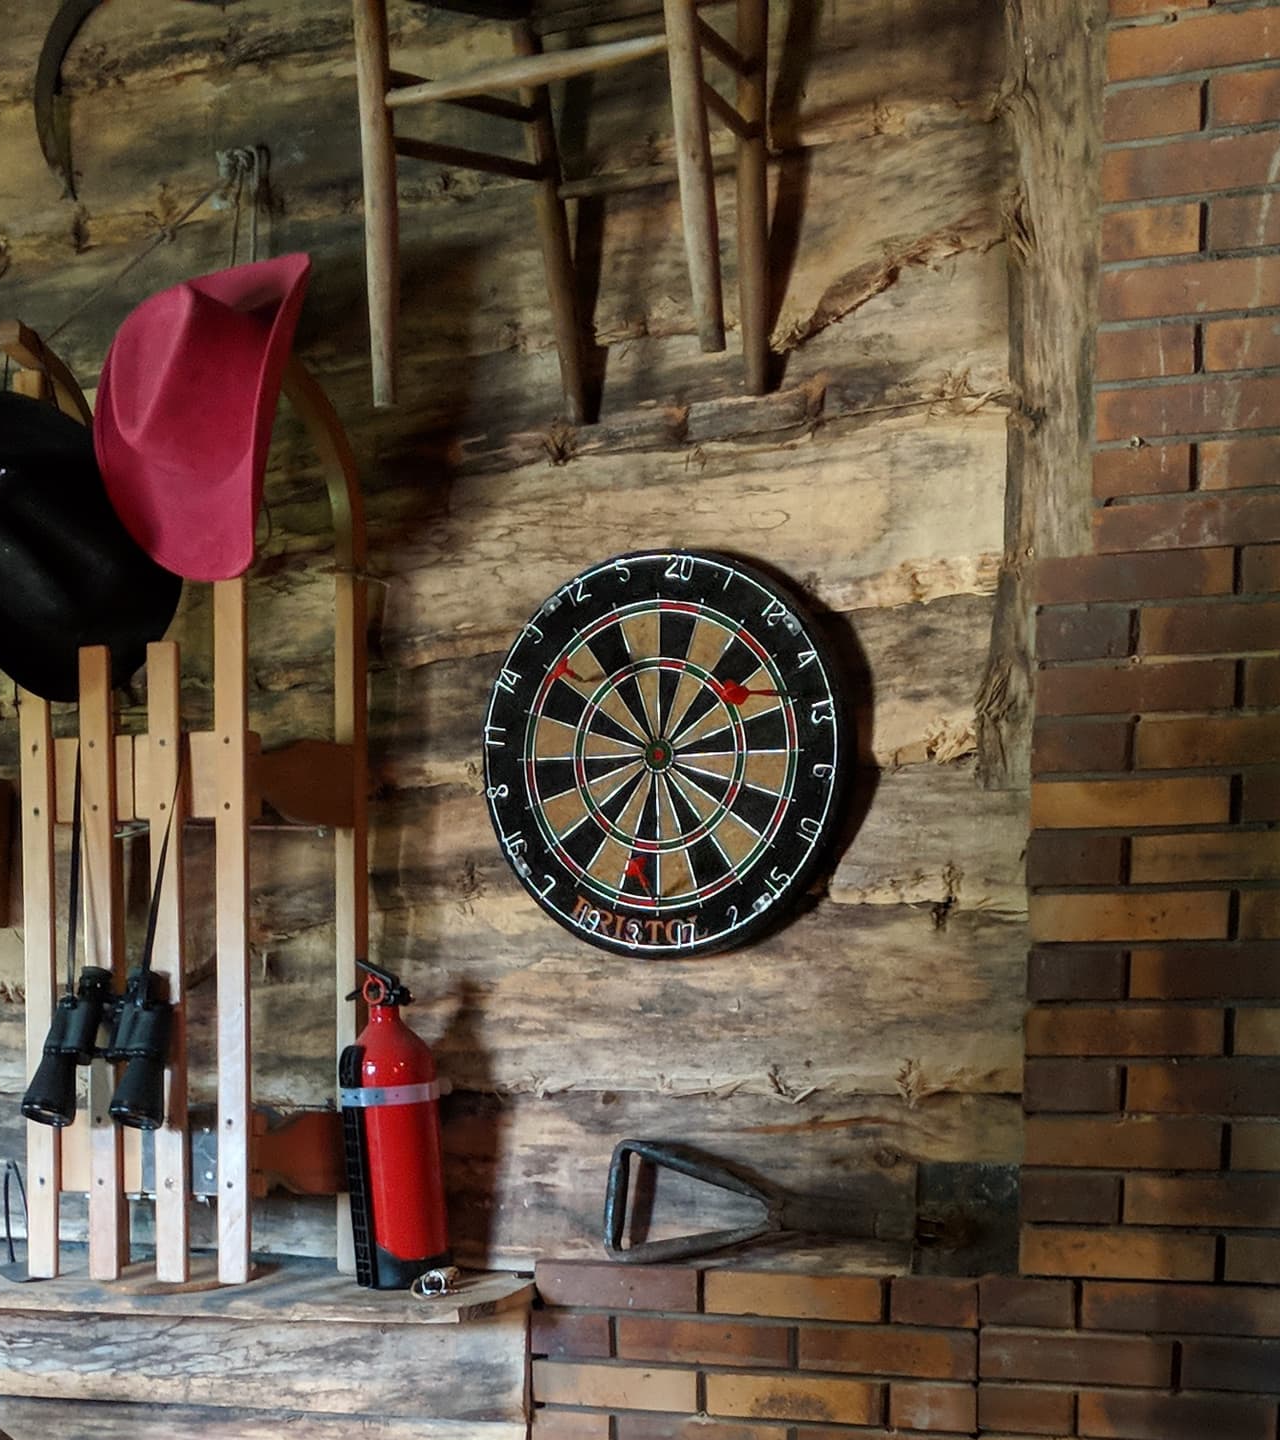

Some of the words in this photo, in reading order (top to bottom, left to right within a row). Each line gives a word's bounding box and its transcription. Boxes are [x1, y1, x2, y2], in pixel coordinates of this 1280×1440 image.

[616, 561, 631, 583] 5
[665, 555, 694, 580] 20
[723, 568, 735, 591] 1
[565, 579, 592, 607] 12
[762, 597, 787, 627] 18
[525, 622, 543, 644] 9
[797, 650, 817, 669] 4
[496, 668, 522, 695] 14
[812, 699, 834, 724] 13
[813, 764, 836, 780] 6
[487, 785, 509, 800] 8
[797, 818, 822, 843] 10
[502, 831, 528, 863] 16
[540, 874, 555, 898] 7
[765, 867, 792, 899] 15
[576, 904, 601, 934] 19
[726, 905, 740, 930] 2
[628, 924, 640, 949] 3
[676, 924, 695, 949] 17
